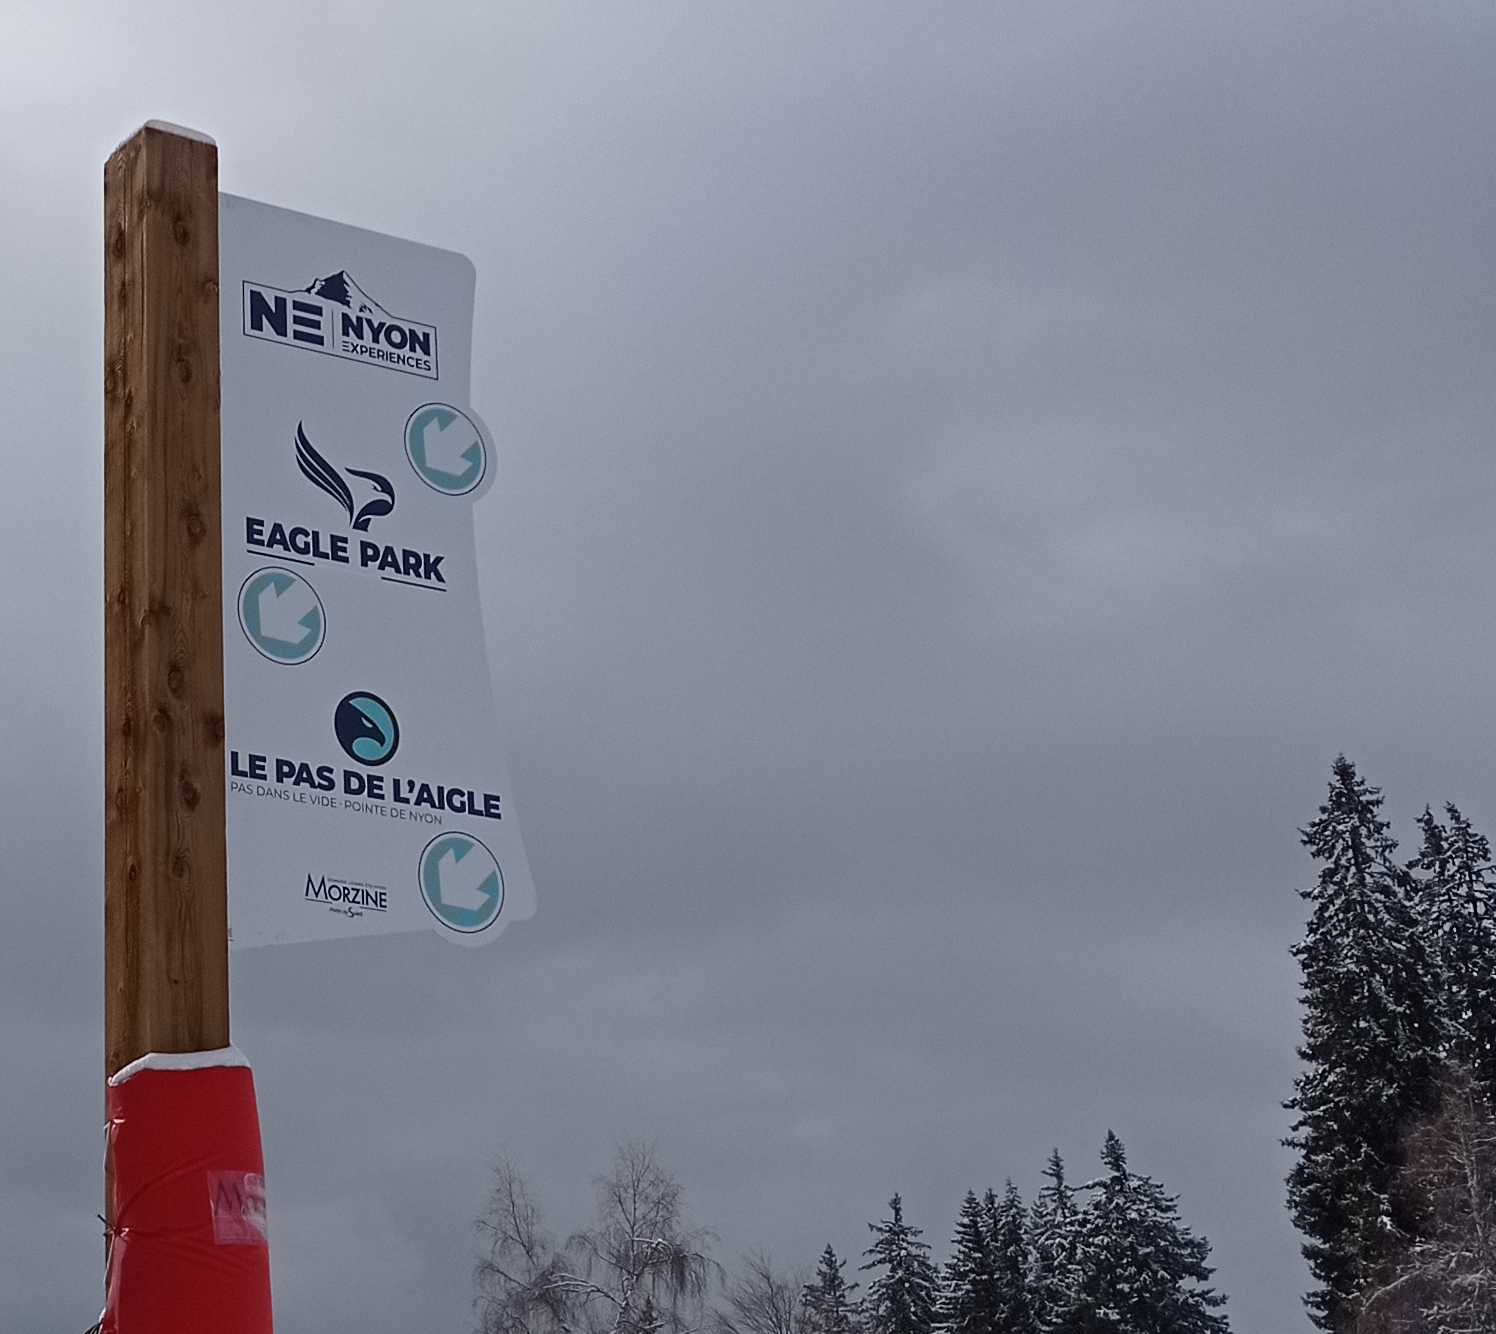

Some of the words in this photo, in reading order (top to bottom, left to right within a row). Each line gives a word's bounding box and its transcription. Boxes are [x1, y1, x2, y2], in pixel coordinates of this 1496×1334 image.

[249, 289, 325, 347] NE
[341, 312, 431, 357] NYON
[342, 340, 432, 372] EXPERIENCES
[245, 516, 350, 564] EAGLE
[360, 539, 446, 584] PARK
[230, 750, 268, 781] LE
[275, 758, 335, 792] PAS
[343, 769, 385, 800] DE
[392, 777, 502, 820] L'AIGLE
[230, 781, 254, 795] PAS
[256, 785, 290, 800] DANS
[293, 792, 307, 803] LE
[309, 794, 338, 808] VIDE
[344, 799, 387, 816] POINTE
[390, 807, 406, 820] DE
[409, 811, 442, 825] NYON
[305, 872, 388, 909] MORZINE
